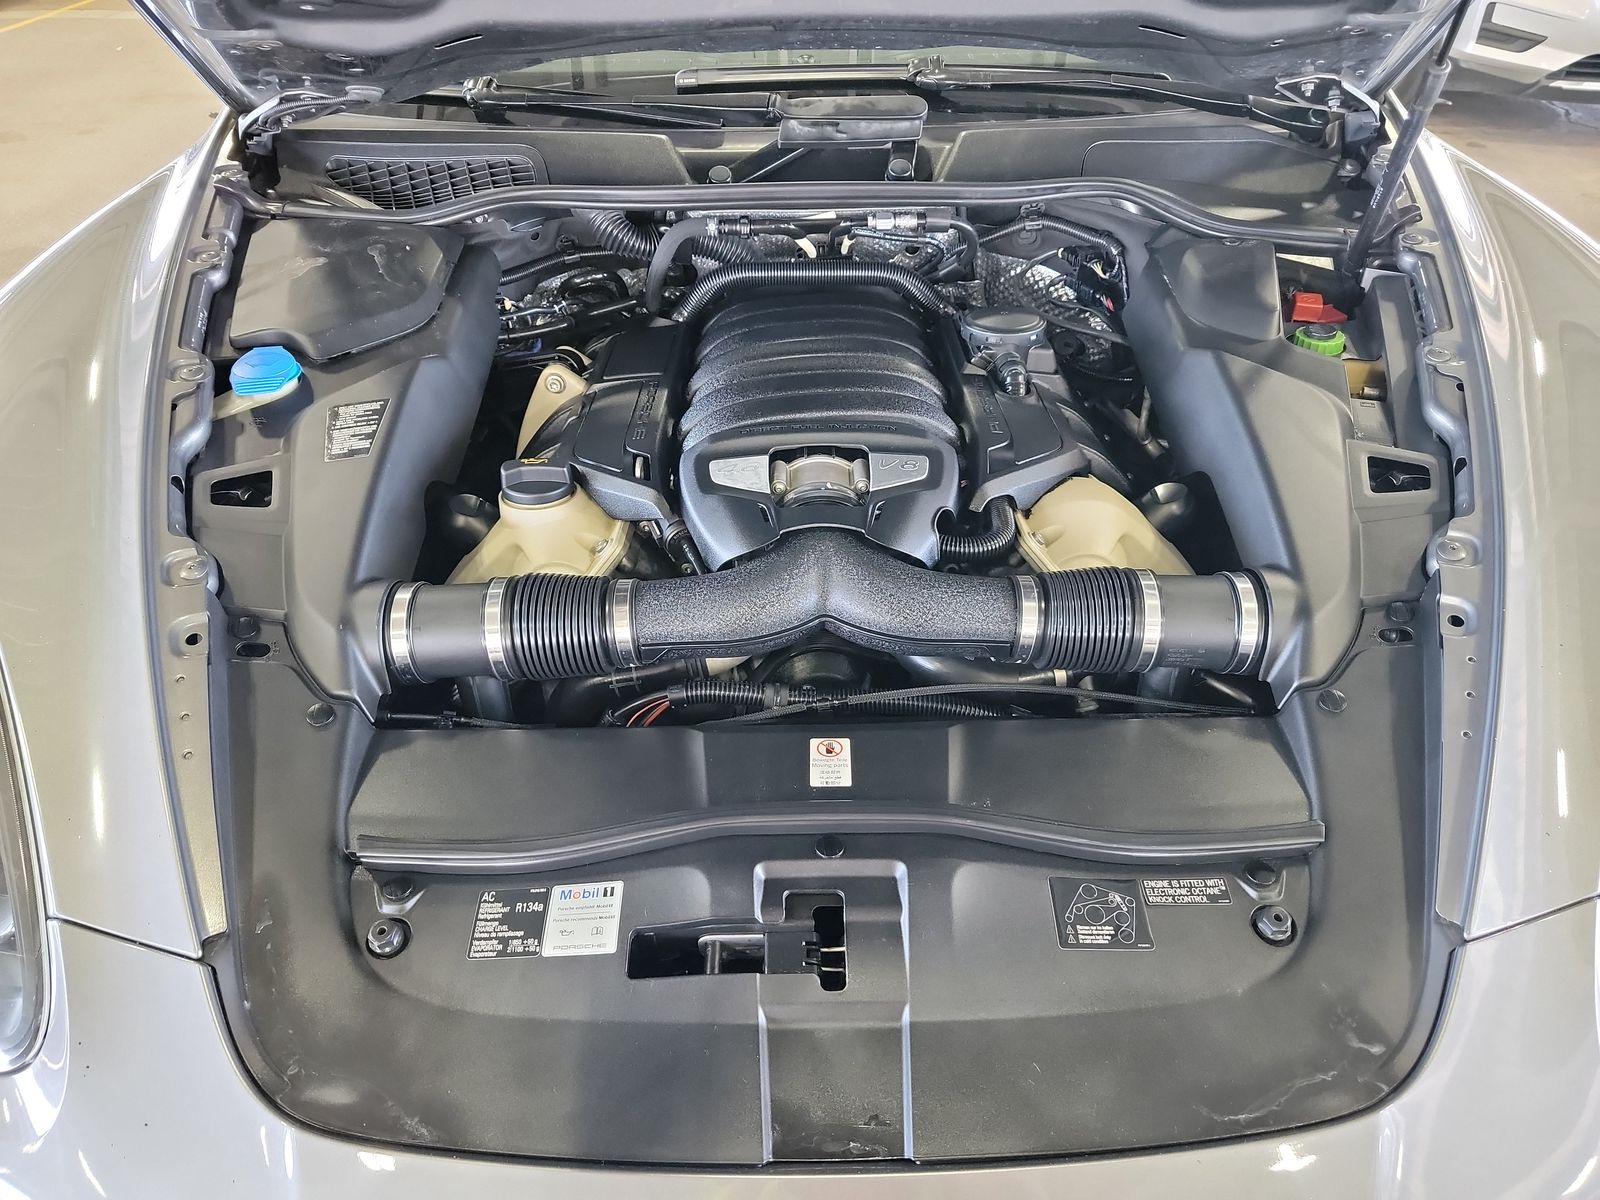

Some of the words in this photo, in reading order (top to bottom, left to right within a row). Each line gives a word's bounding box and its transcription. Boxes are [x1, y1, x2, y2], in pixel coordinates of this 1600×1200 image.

[879, 459, 920, 470] V8
[1143, 880, 1171, 888] ENGINE
[1205, 879, 1224, 887] WITH
[481, 891, 496, 902] AC
[560, 887, 599, 900] Mobil
[603, 887, 615, 898] 1
[1146, 888, 1191, 896] ELECTRONIC
[1192, 887, 1221, 895] OCTANE
[1175, 895, 1210, 903] CONTROL
[515, 902, 544, 913] R134a
[552, 943, 607, 951] PORSCHE
